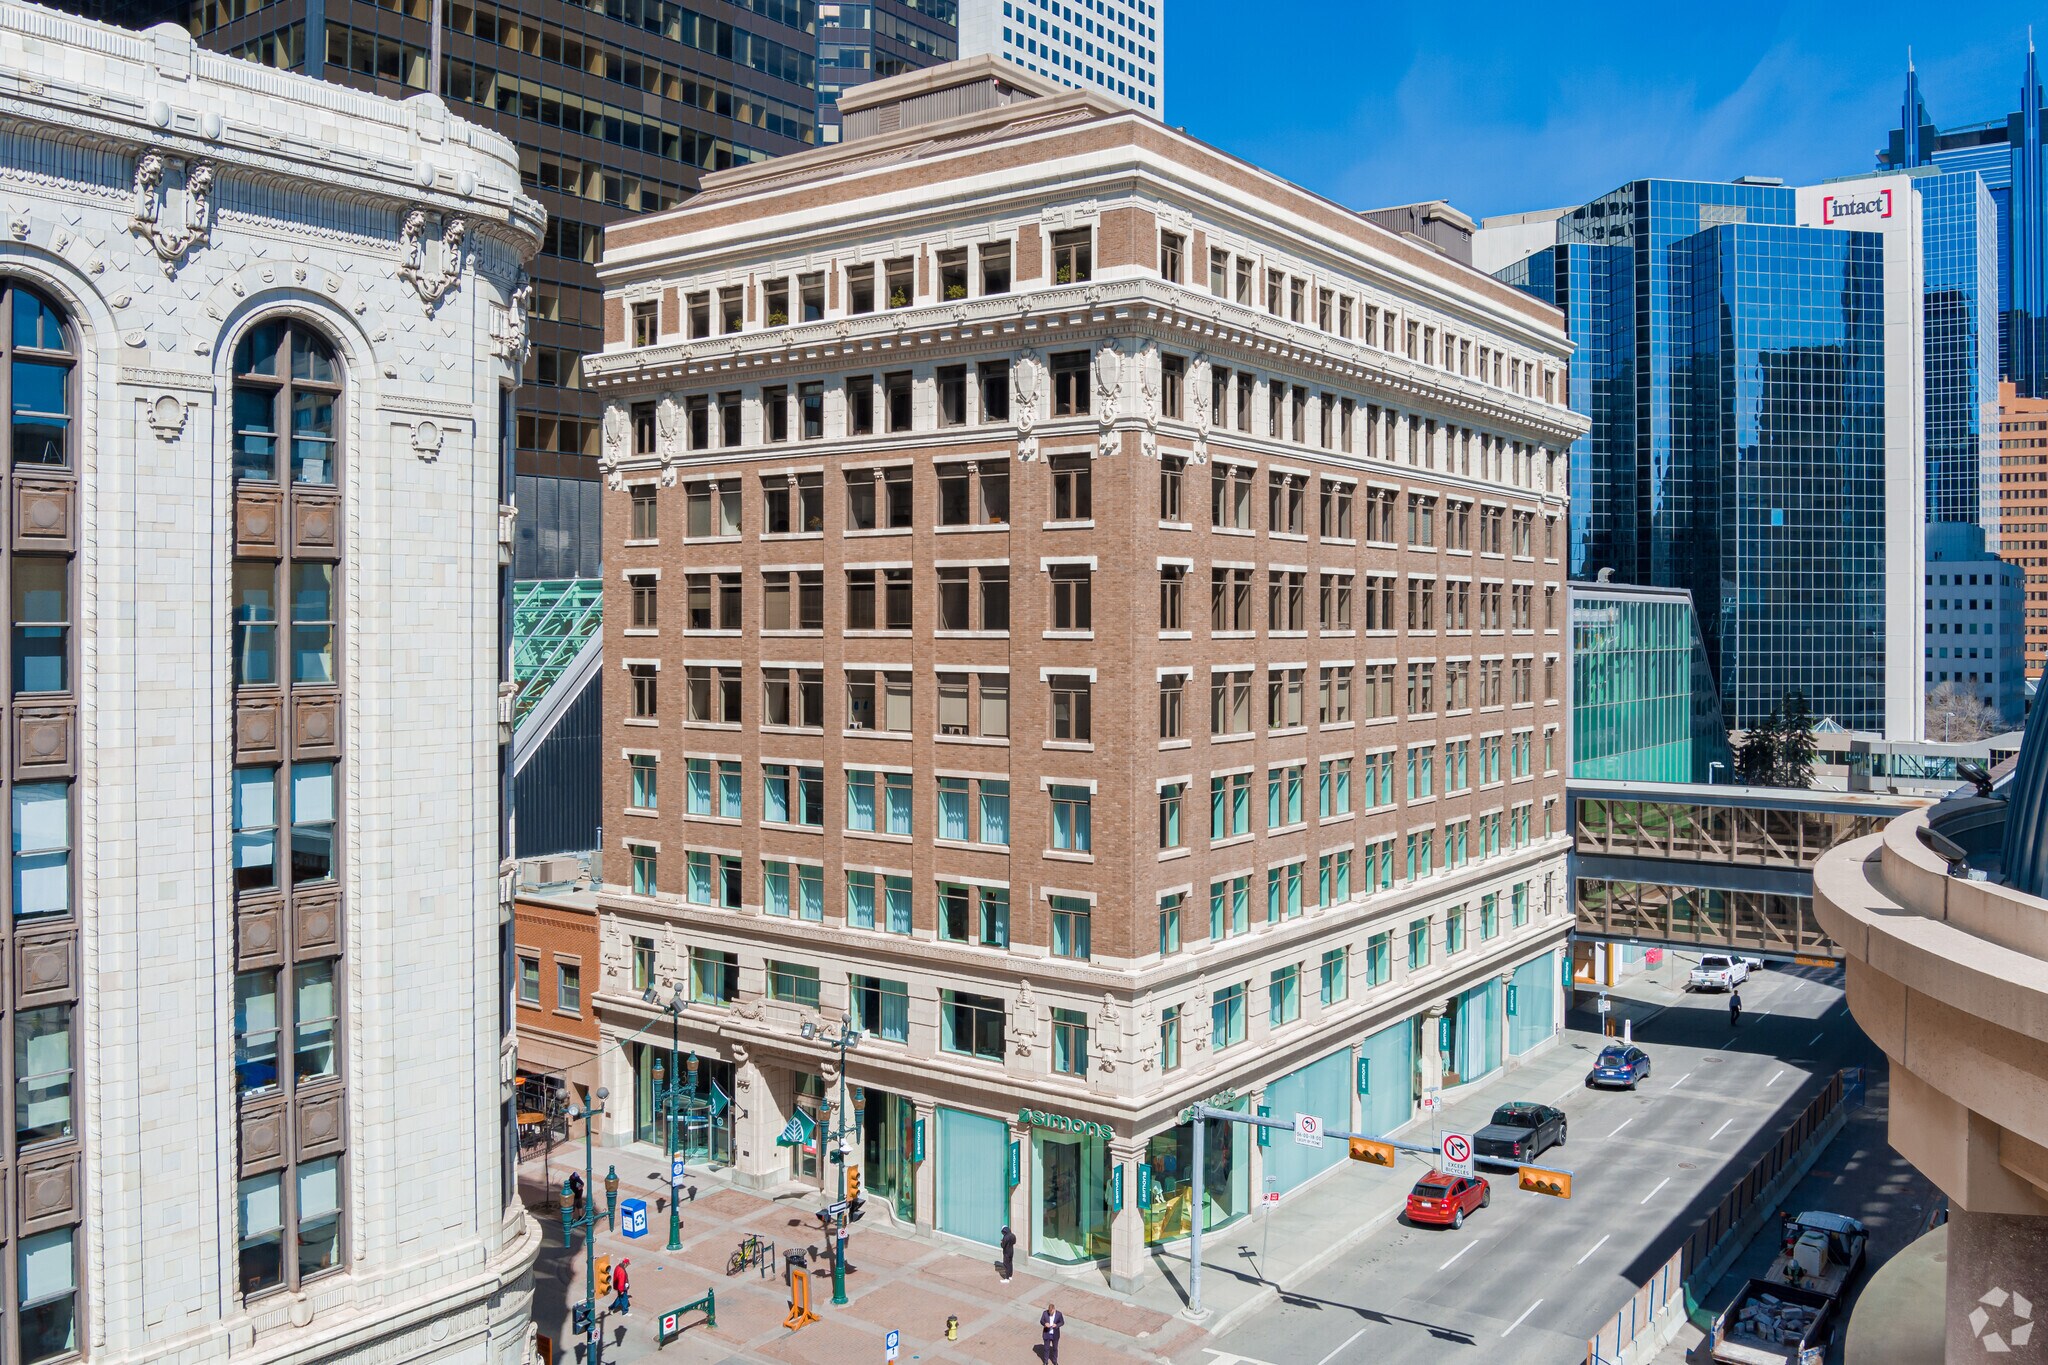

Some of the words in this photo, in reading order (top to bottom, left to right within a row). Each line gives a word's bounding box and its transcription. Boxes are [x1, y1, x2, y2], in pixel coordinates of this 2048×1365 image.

[1031, 1109, 1116, 1141] simons
[1447, 1162, 1467, 1170] EXCEPT
[1445, 1167, 1470, 1176] BICYCLES
